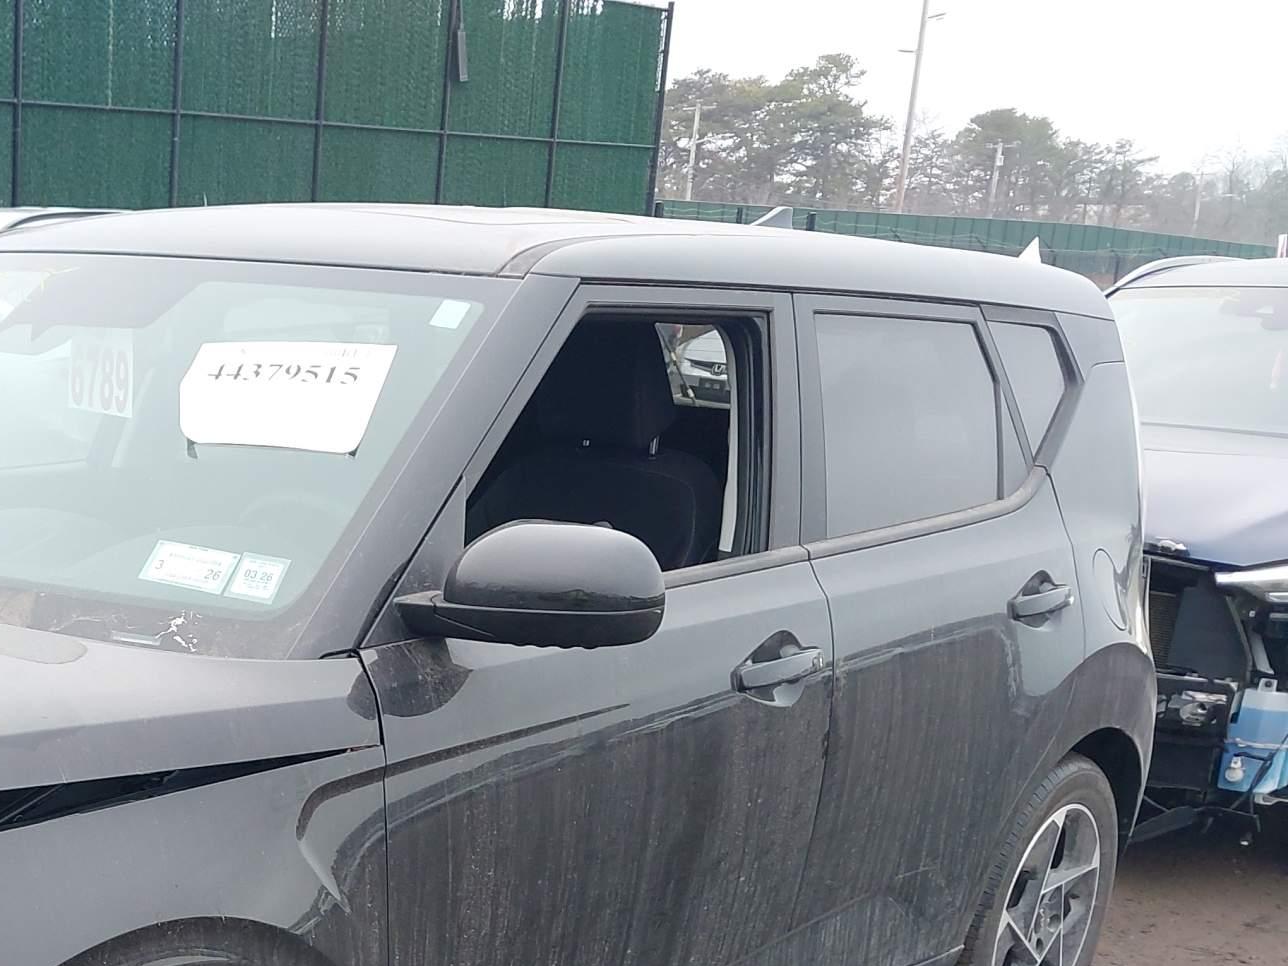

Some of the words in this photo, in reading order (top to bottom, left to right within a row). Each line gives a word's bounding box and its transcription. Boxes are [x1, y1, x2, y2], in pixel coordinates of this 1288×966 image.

[70, 348, 129, 414] 6789
[207, 363, 361, 385] 44379515
[204, 568, 222, 581] 26
